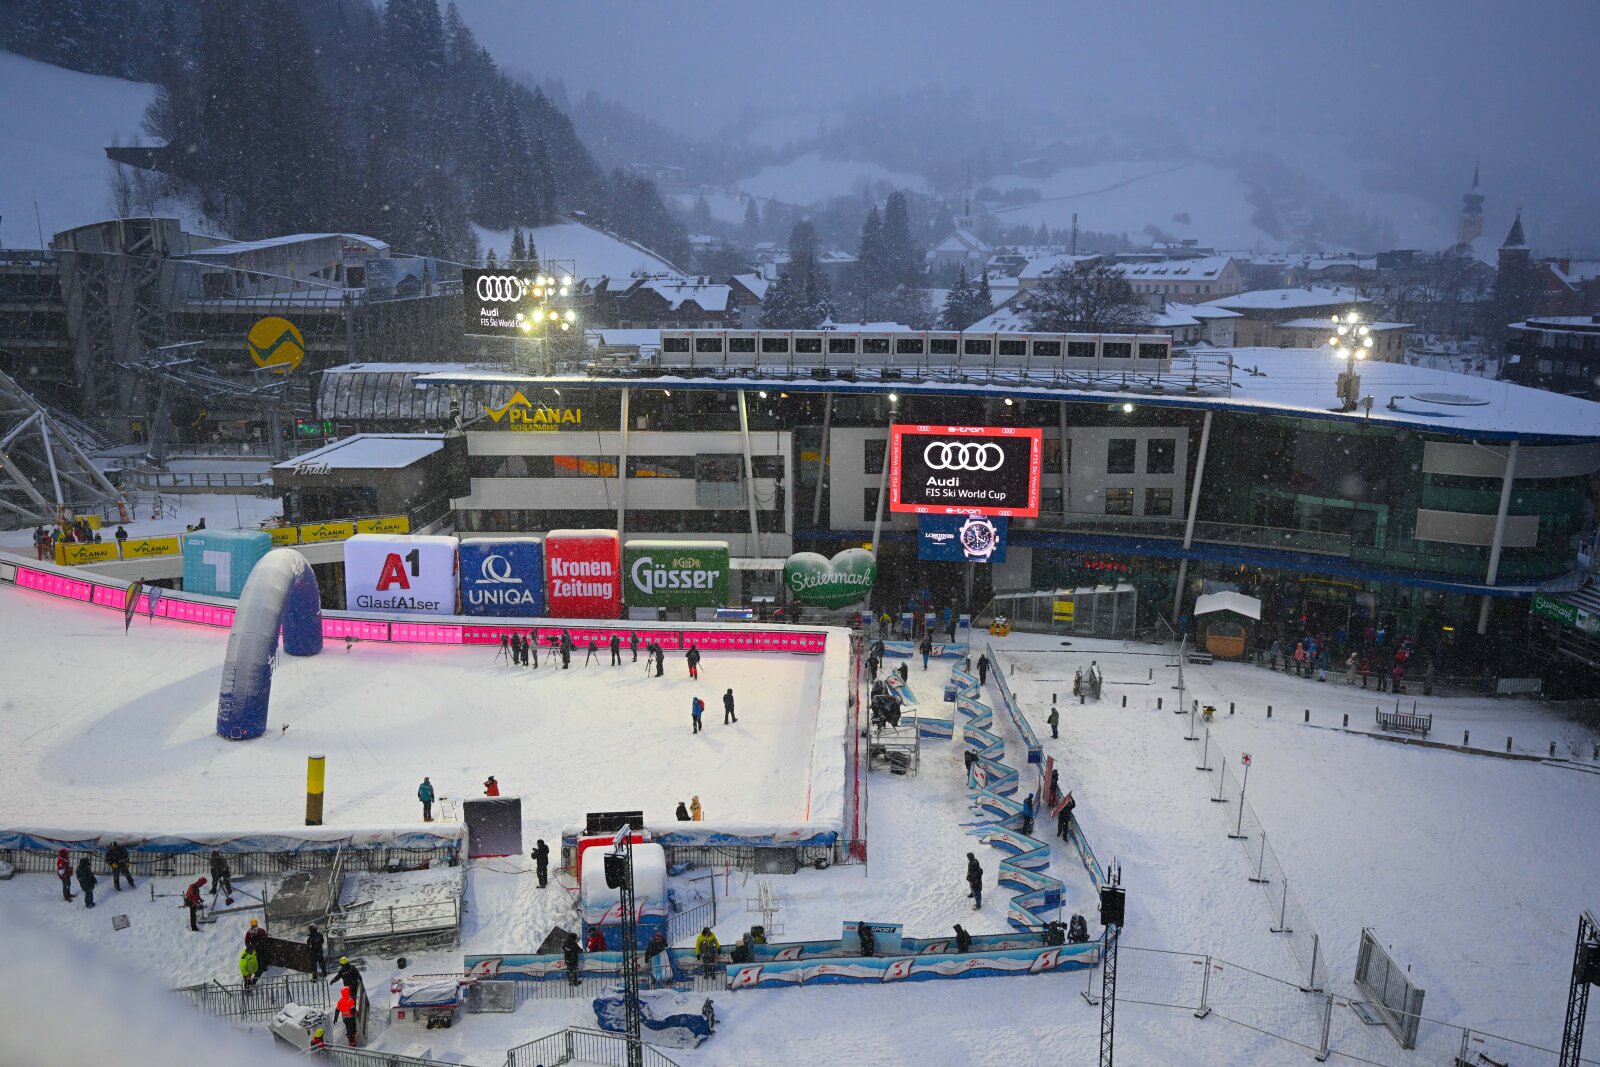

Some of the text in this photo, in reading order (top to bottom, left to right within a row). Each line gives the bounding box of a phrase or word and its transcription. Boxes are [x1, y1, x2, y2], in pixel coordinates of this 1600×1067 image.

[480, 308, 499, 316] Audi
[510, 409, 581, 423] PLANAI
[926, 477, 959, 486] Audi
[943, 489, 956, 498] Ski
[958, 490, 986, 498] World
[989, 491, 1006, 500] Cup
[376, 549, 419, 591] A1
[551, 558, 612, 576] Kronen
[1084, 560, 1126, 573] SPORTS
[631, 556, 720, 594] Gösser
[792, 567, 872, 591] Steiermark
[468, 589, 534, 604] UNIQA
[553, 578, 612, 600] Zeitung
[357, 595, 440, 610] GlasfA1ser
